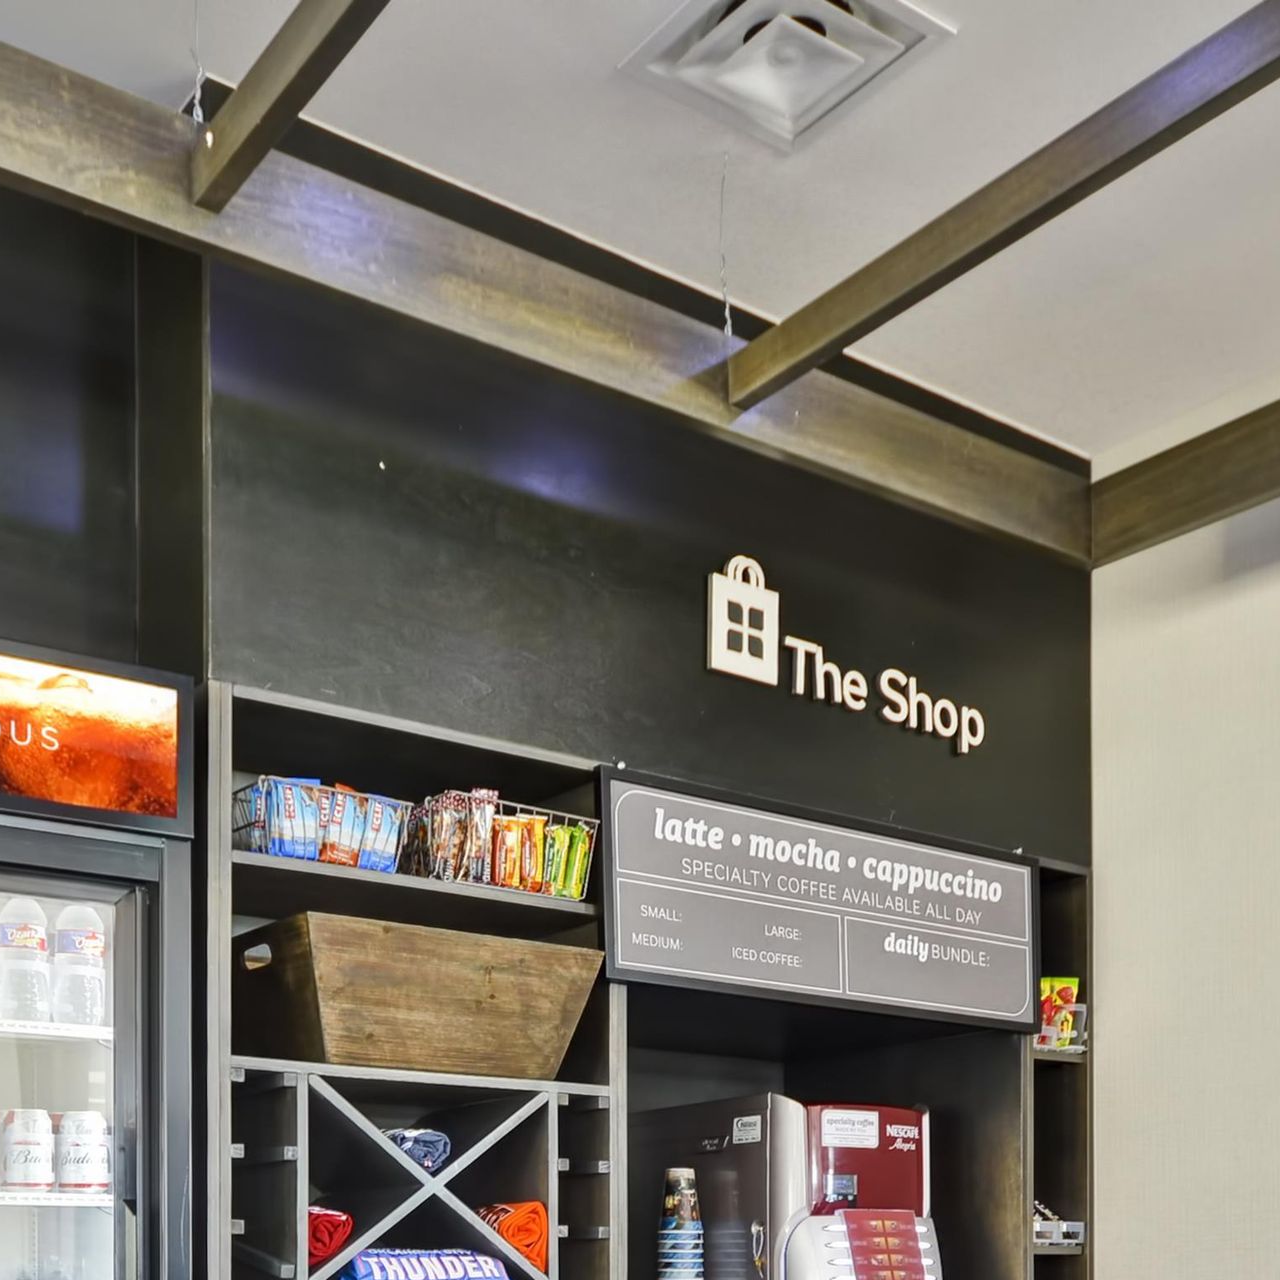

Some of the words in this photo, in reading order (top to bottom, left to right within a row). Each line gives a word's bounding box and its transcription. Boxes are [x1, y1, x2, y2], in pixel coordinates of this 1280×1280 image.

[784, 634, 869, 711] The
[880, 668, 985, 754] Shop
[654, 808, 724, 850] latte
[749, 833, 841, 873] mocha
[862, 854, 1004, 904] cappuccino
[681, 858, 773, 890] SPECIALTY
[776, 875, 838, 902] COFFEE
[841, 888, 921, 916] AVAILABLE
[924, 903, 953, 922] ALL
[955, 908, 983, 927] DAY
[640, 905, 682, 922] SMALL:
[631, 932, 683, 951] MEDIUM:
[764, 924, 803, 942] LARGE:
[731, 947, 759, 963] ICED
[760, 950, 803, 969] COFFEE:
[883, 932, 930, 963] daily
[930, 945, 991, 968] BUNDLE:
[361, 1255, 501, 1280] THUNDER
